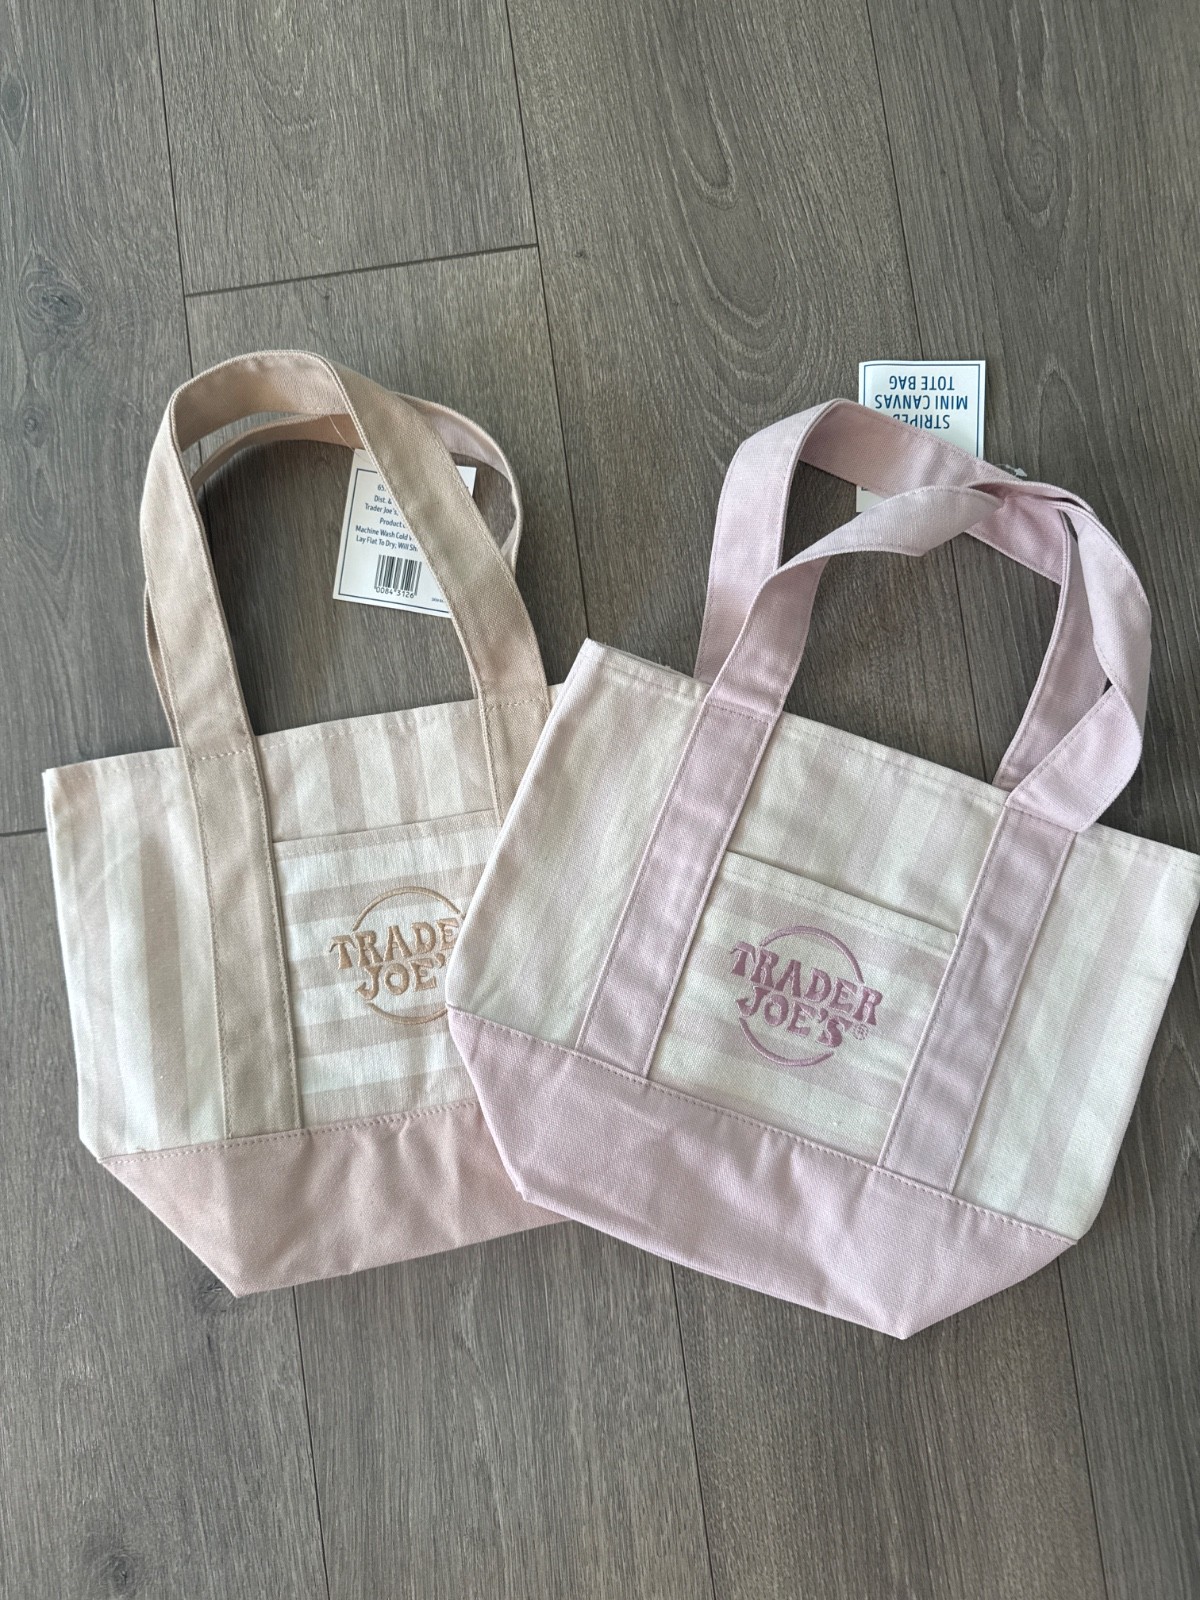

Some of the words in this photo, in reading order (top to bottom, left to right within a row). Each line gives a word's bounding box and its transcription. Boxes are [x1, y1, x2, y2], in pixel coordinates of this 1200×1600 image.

[889, 375, 916, 390] BAG
[921, 376, 955, 391] TOTE
[874, 394, 930, 410] CANVAS
[934, 395, 968, 410] MINI
[365, 502, 382, 513] Trader
[380, 517, 402, 527] Product
[355, 524, 379, 536] Machine
[380, 529, 395, 538] Wash
[395, 531, 409, 541] Cold
[356, 534, 366, 544] Lay
[367, 536, 378, 545] Flat
[379, 538, 385, 546] To
[398, 541, 409, 551] Will
[409, 543, 418, 552] Sh
[329, 917, 459, 970] TRADE
[355, 952, 446, 1001] JOE'
[730, 940, 883, 1026] TRADER
[735, 985, 853, 1048] JOE'S
